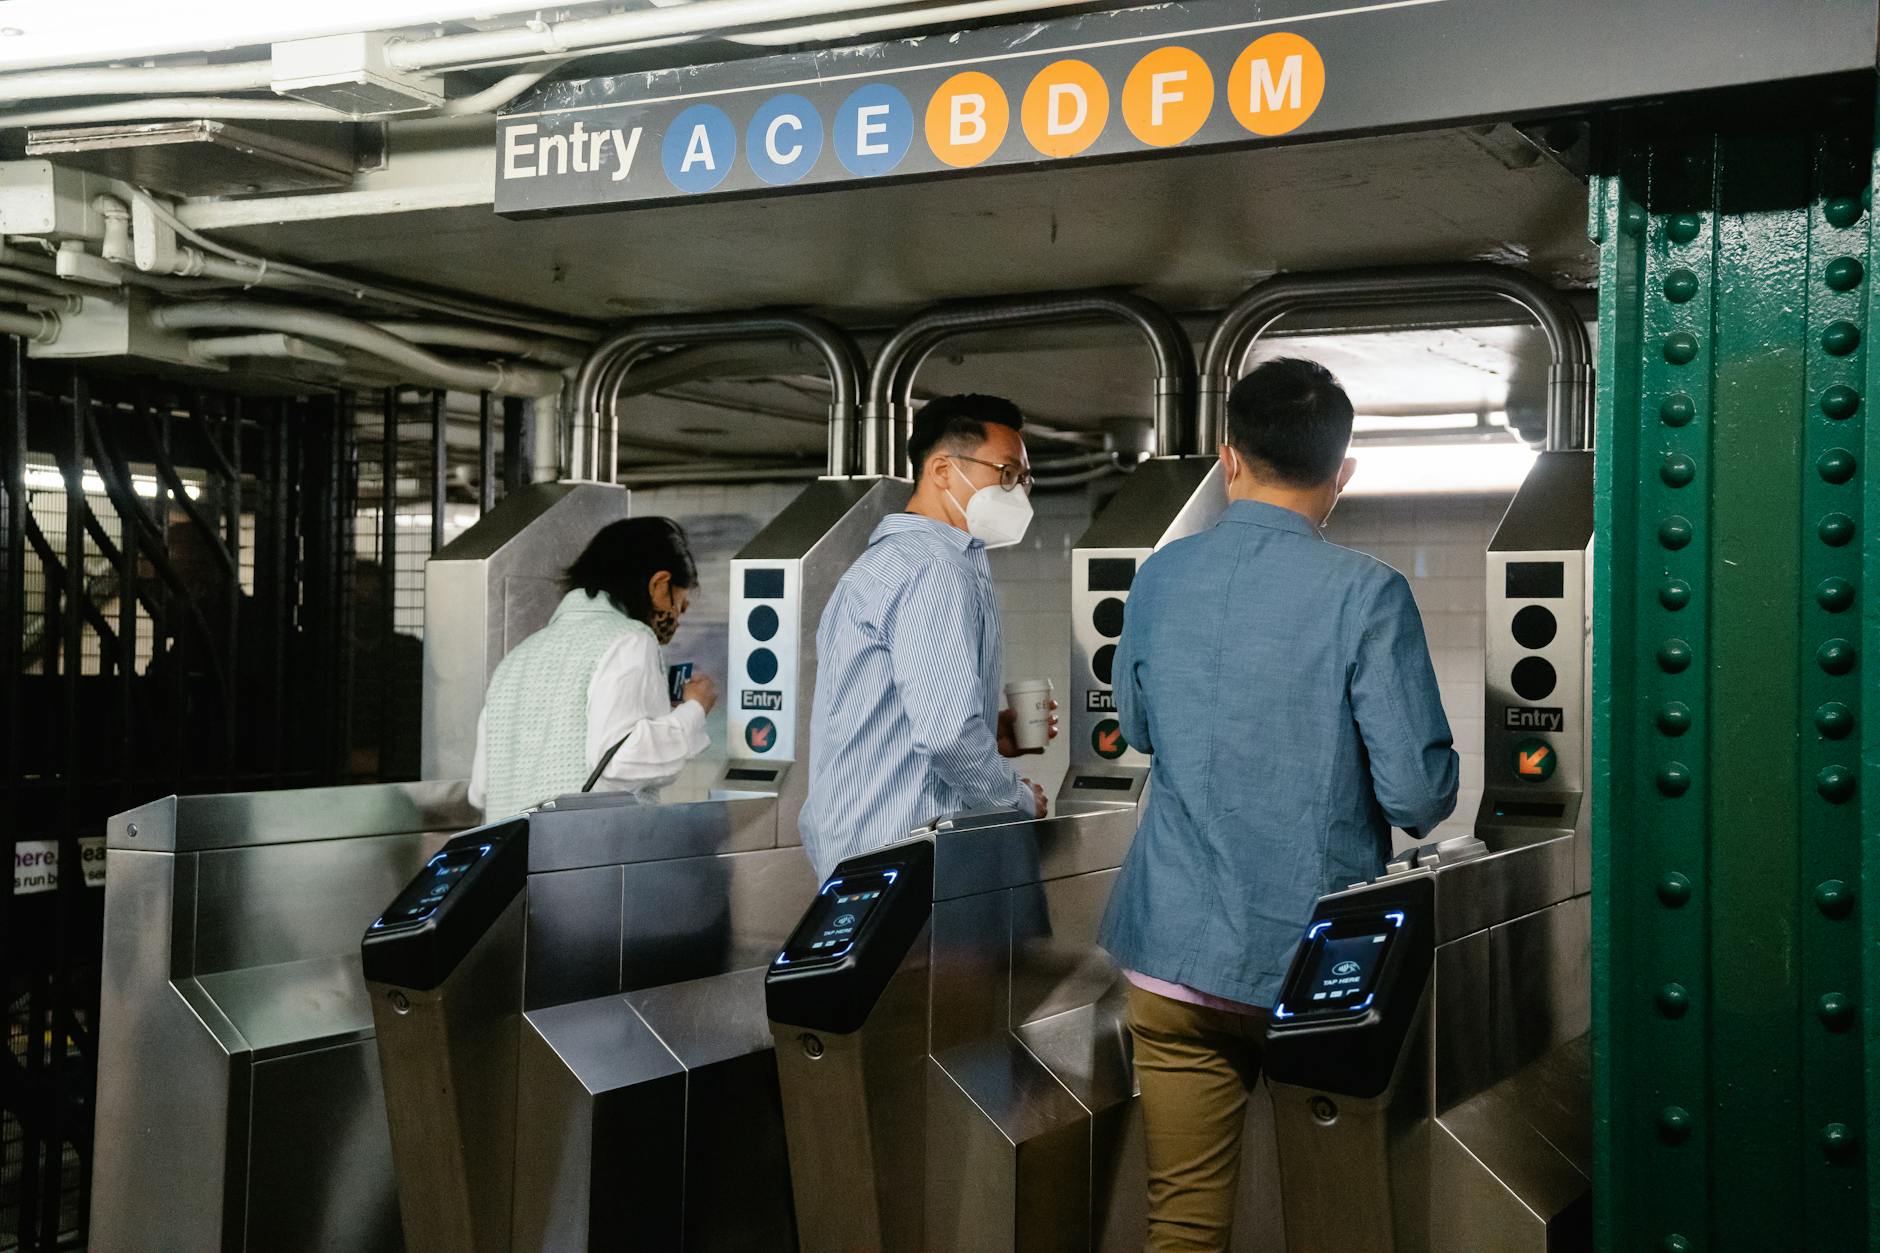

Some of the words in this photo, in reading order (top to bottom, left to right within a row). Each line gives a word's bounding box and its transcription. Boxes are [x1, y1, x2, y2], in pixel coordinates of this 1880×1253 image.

[503, 121, 643, 181] Entry
[680, 124, 716, 173] A
[765, 114, 803, 165] C
[856, 104, 890, 156] E
[949, 93, 987, 146] B
[1047, 82, 1088, 136] D
[1151, 70, 1188, 126] F
[1249, 54, 1303, 113] M
[742, 690, 782, 709] Entry
[1088, 691, 1116, 708] Ent
[1506, 707, 1562, 731] Entry
[24, 876, 45, 886] run
[1338, 976, 1361, 984] HERE
